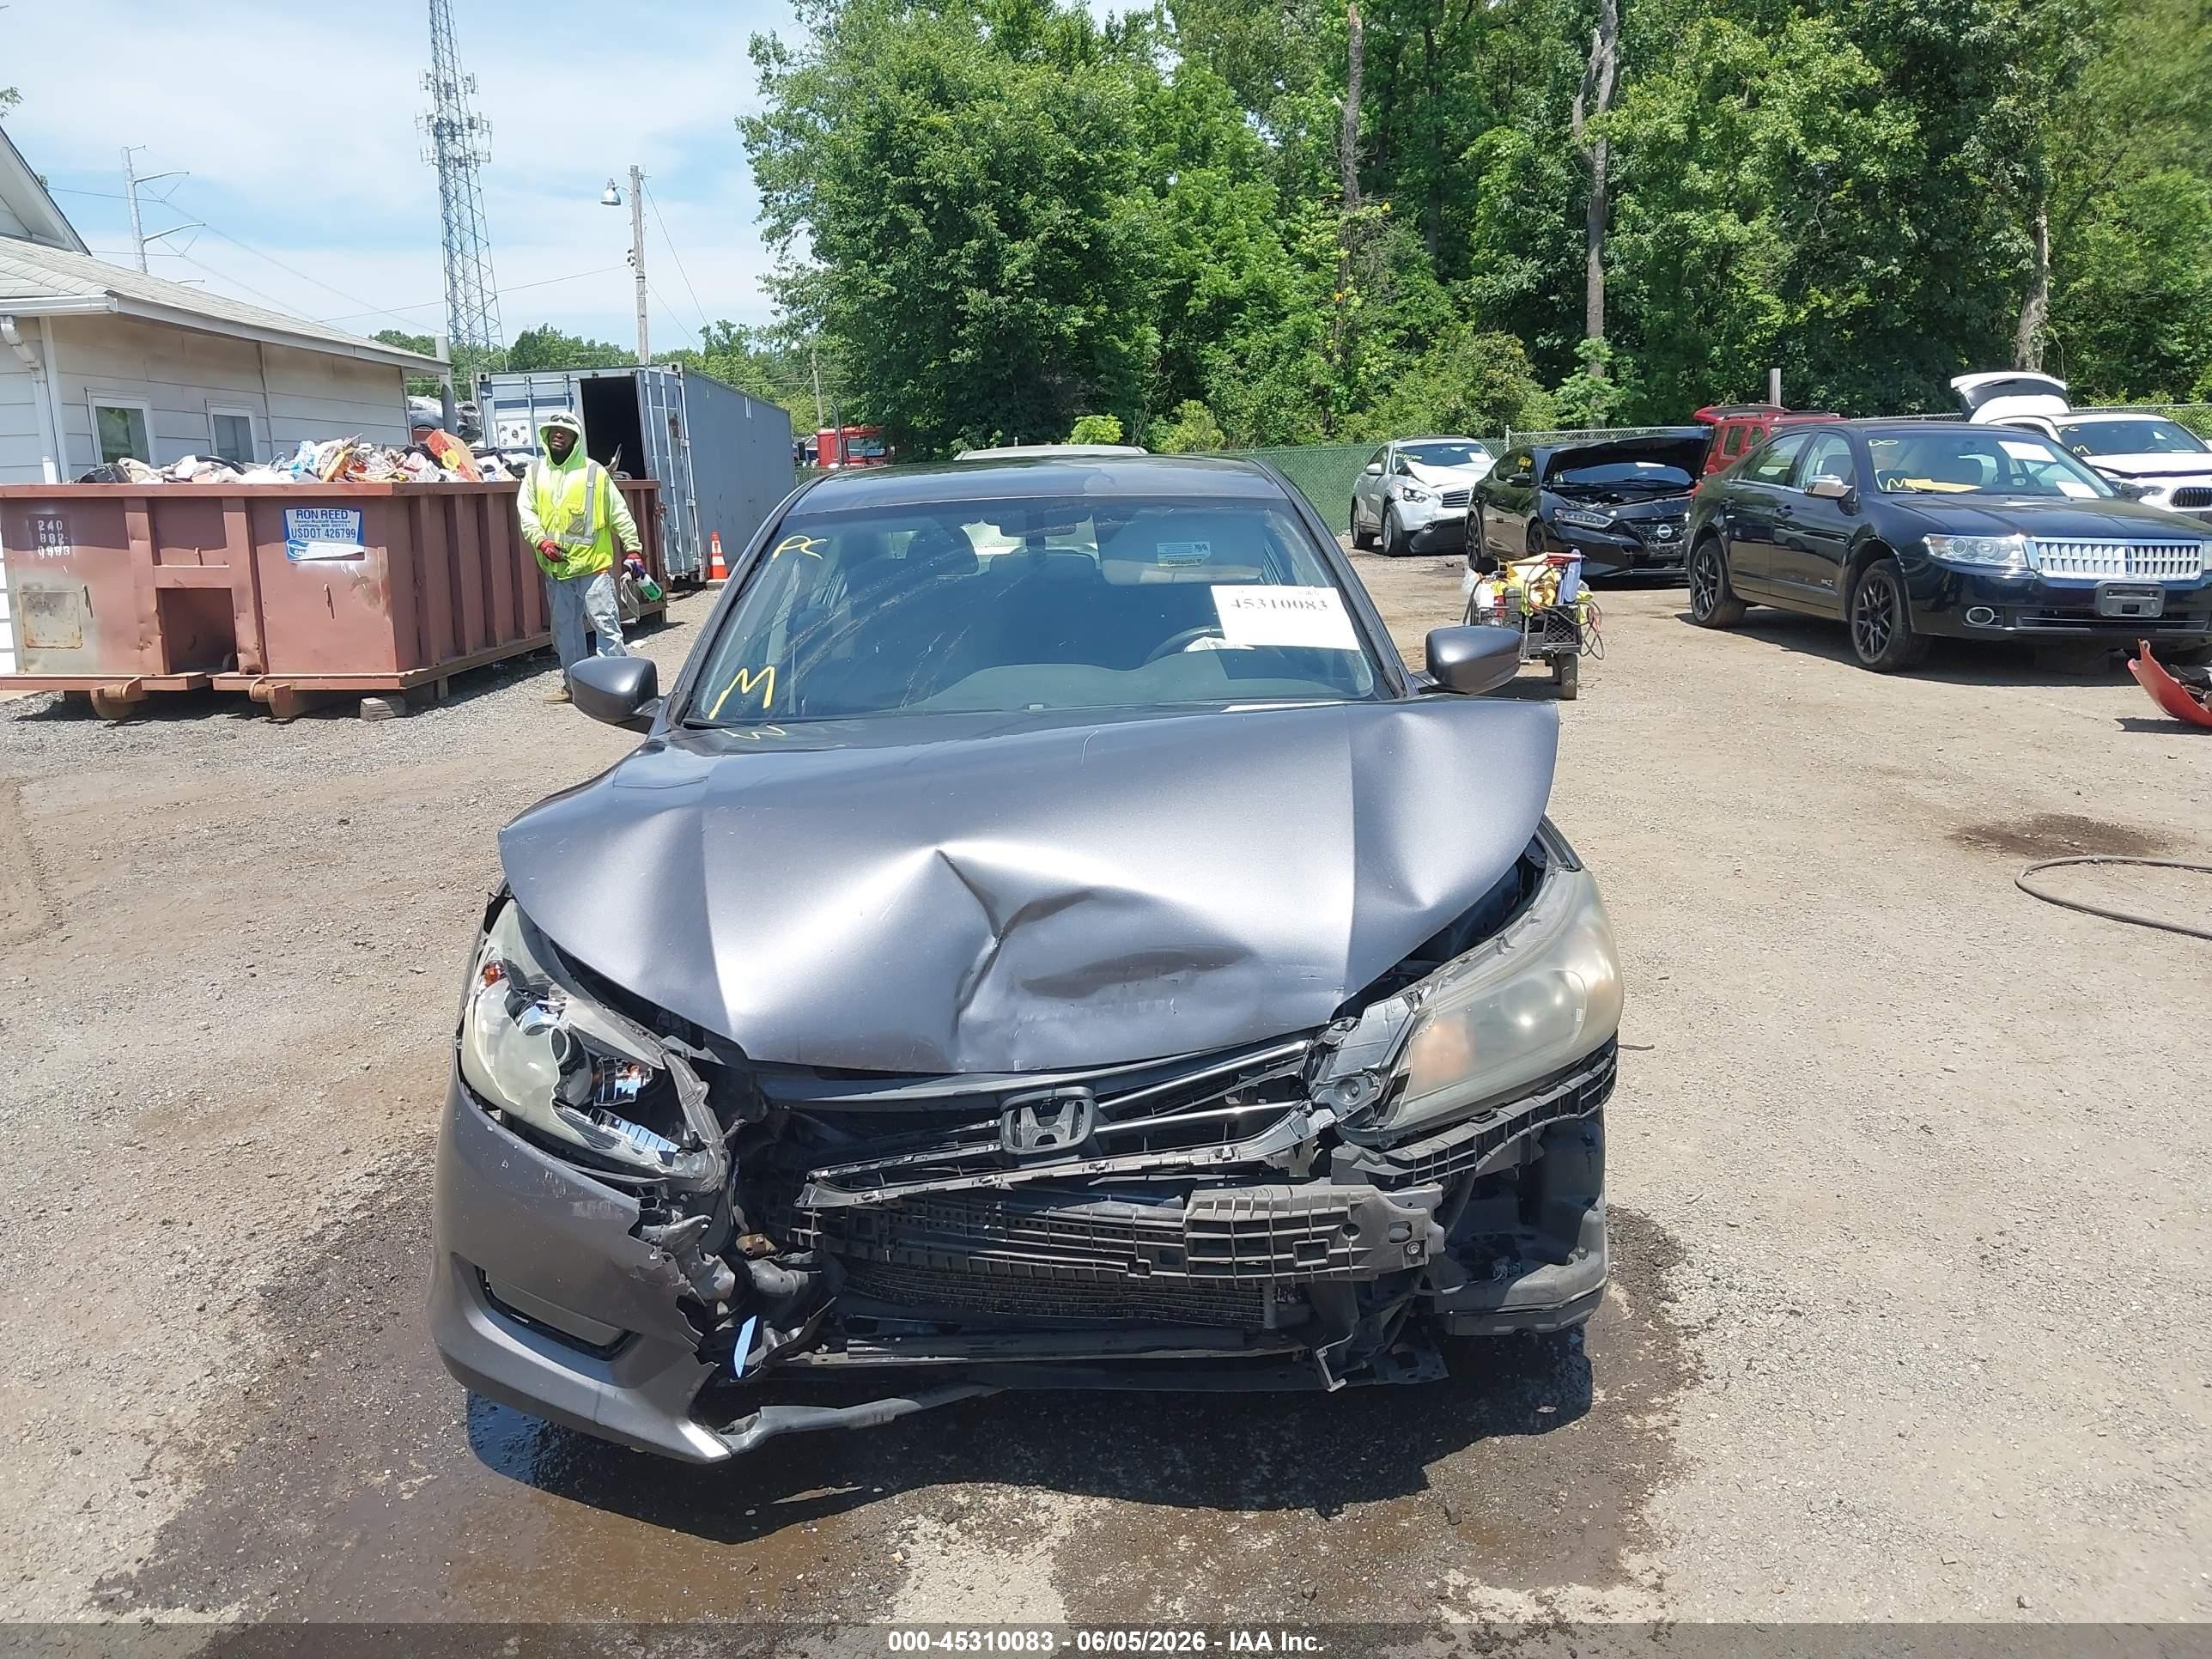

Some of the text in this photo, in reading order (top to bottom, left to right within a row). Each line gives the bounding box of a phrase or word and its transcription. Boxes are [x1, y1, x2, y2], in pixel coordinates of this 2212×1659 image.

[296, 510, 348, 519] RON REED
[291, 528, 356, 538] USDOT 426799
[1231, 598, 1328, 611] 45310083
[708, 665, 776, 720] M
